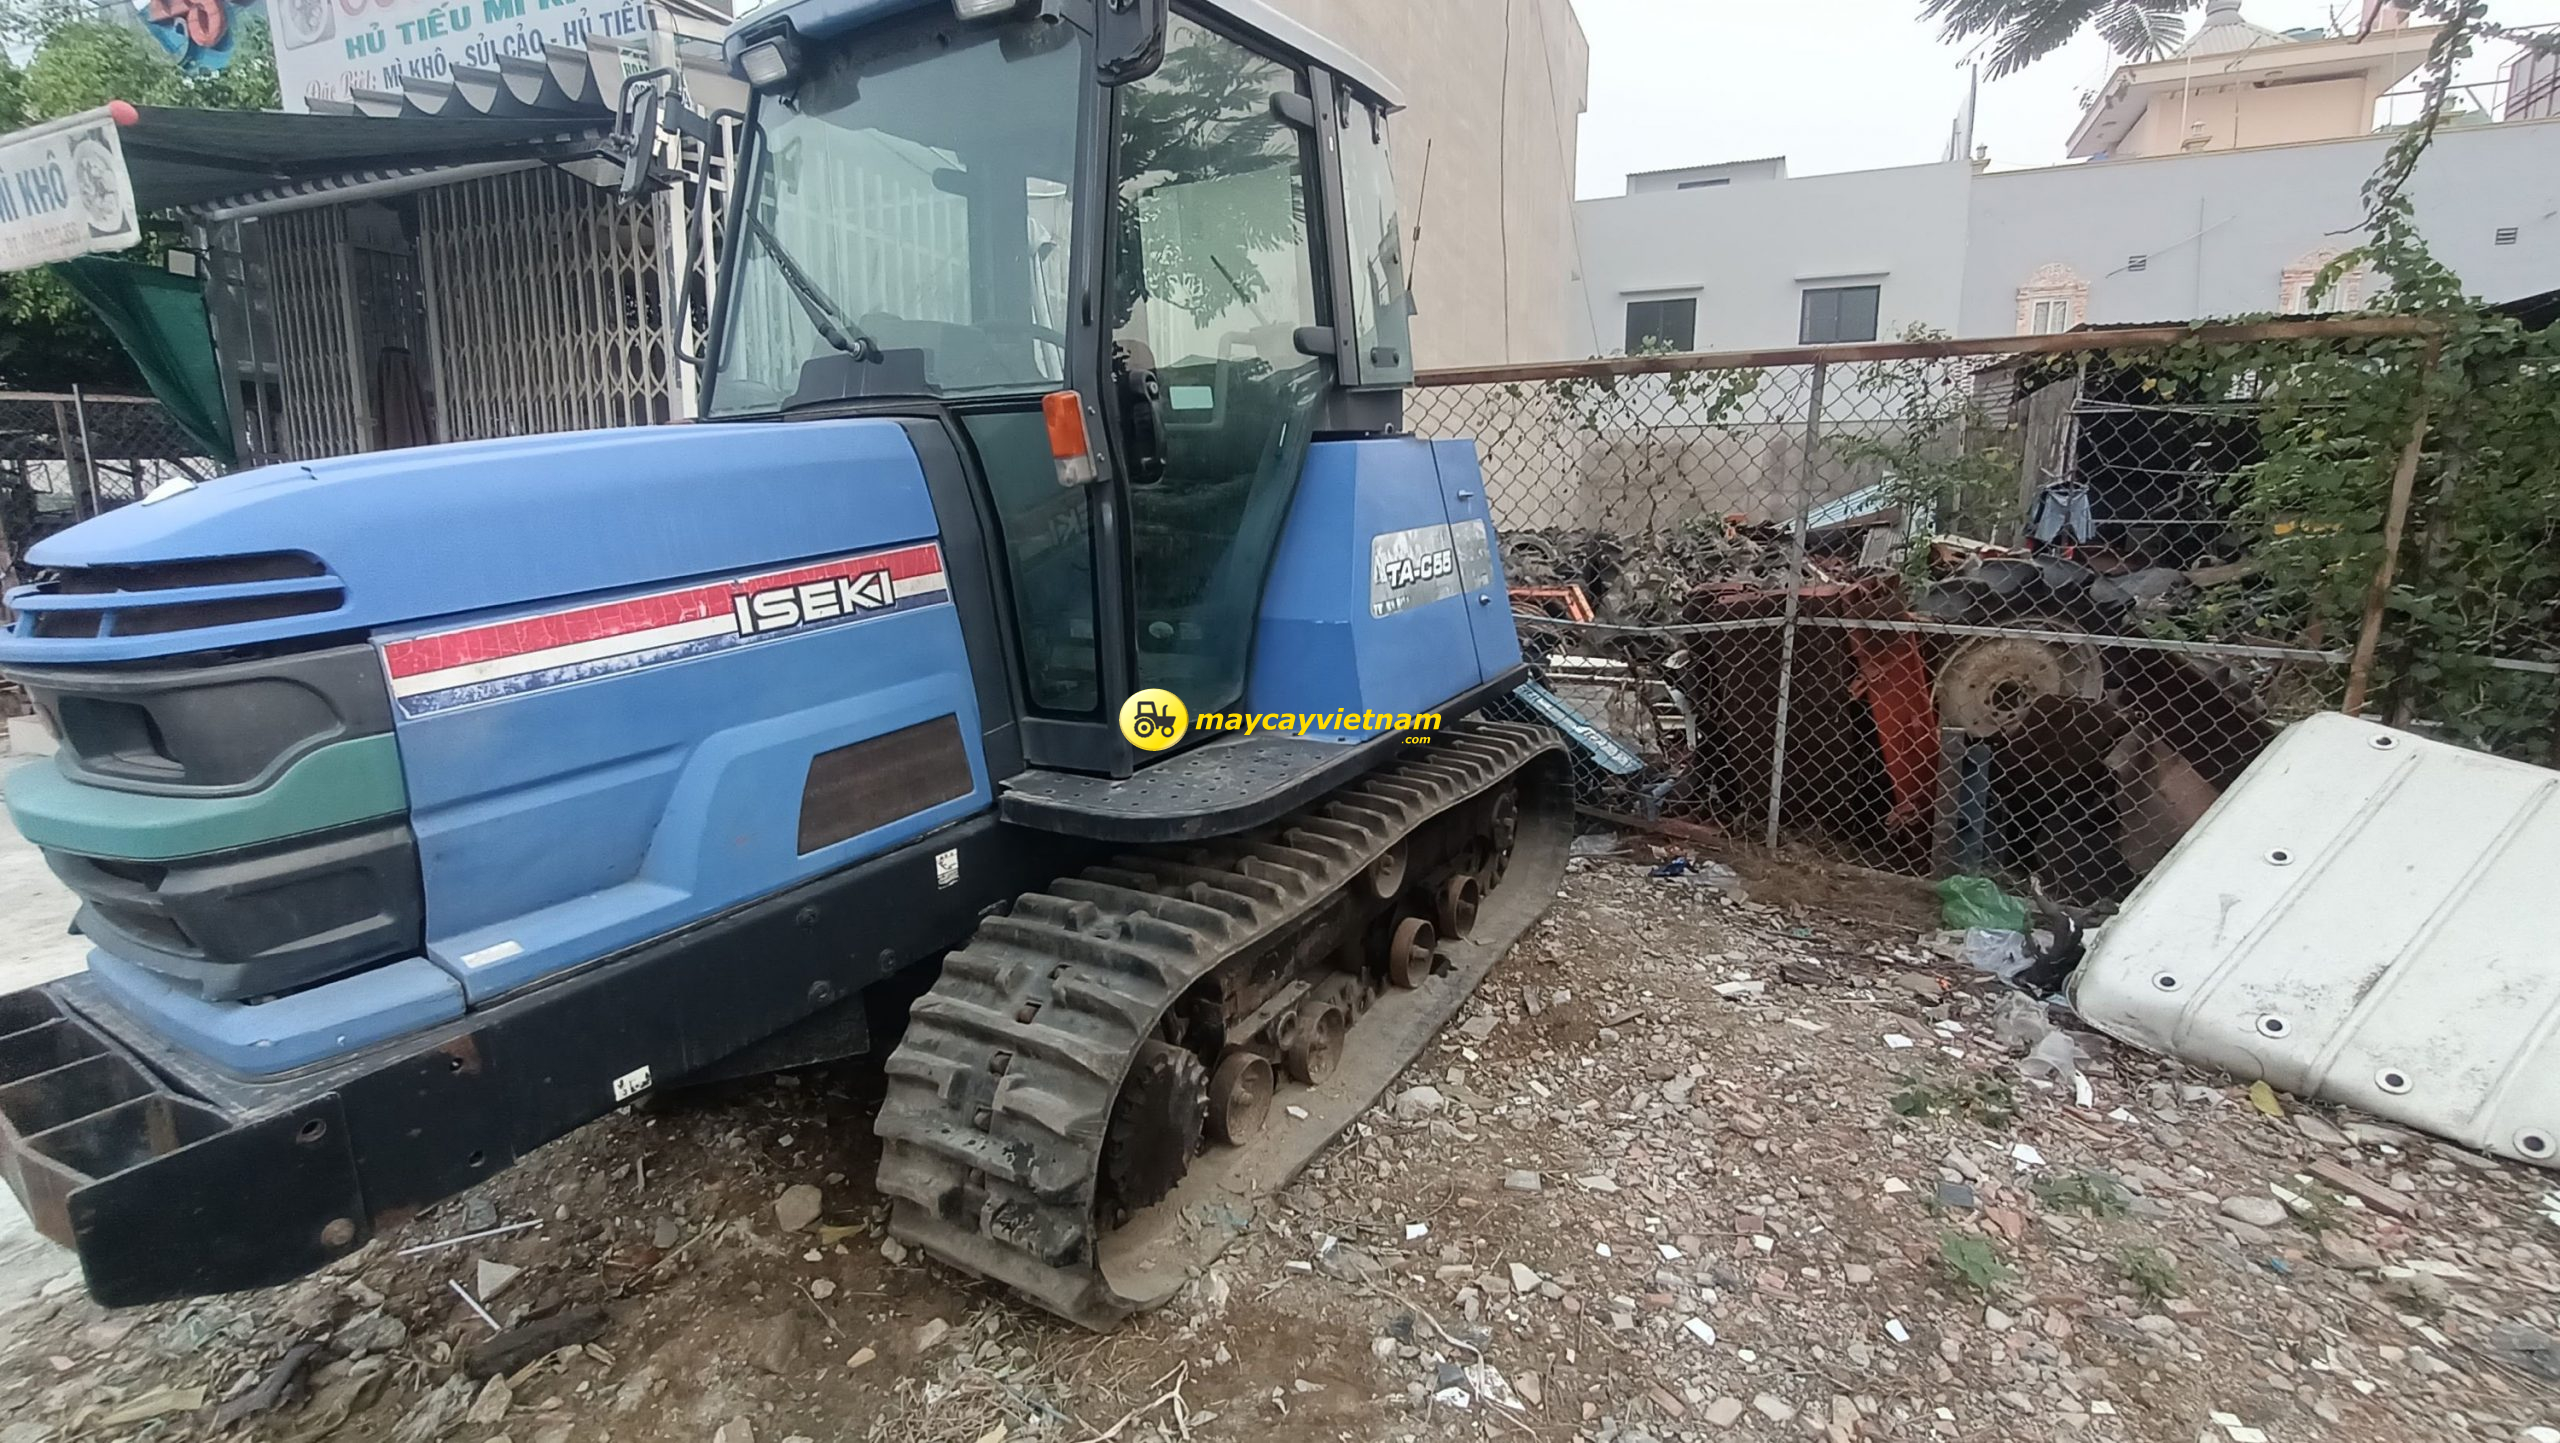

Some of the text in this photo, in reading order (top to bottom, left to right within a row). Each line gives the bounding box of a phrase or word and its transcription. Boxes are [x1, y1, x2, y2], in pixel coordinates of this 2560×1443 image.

[345, 22, 386, 60] HỦ
[395, 1, 472, 46] TIẾU
[409, 46, 447, 80] KHÔ
[503, 23, 543, 57] CẢO
[15, 149, 69, 217] KHÔ
[731, 567, 896, 638] ISEKI
